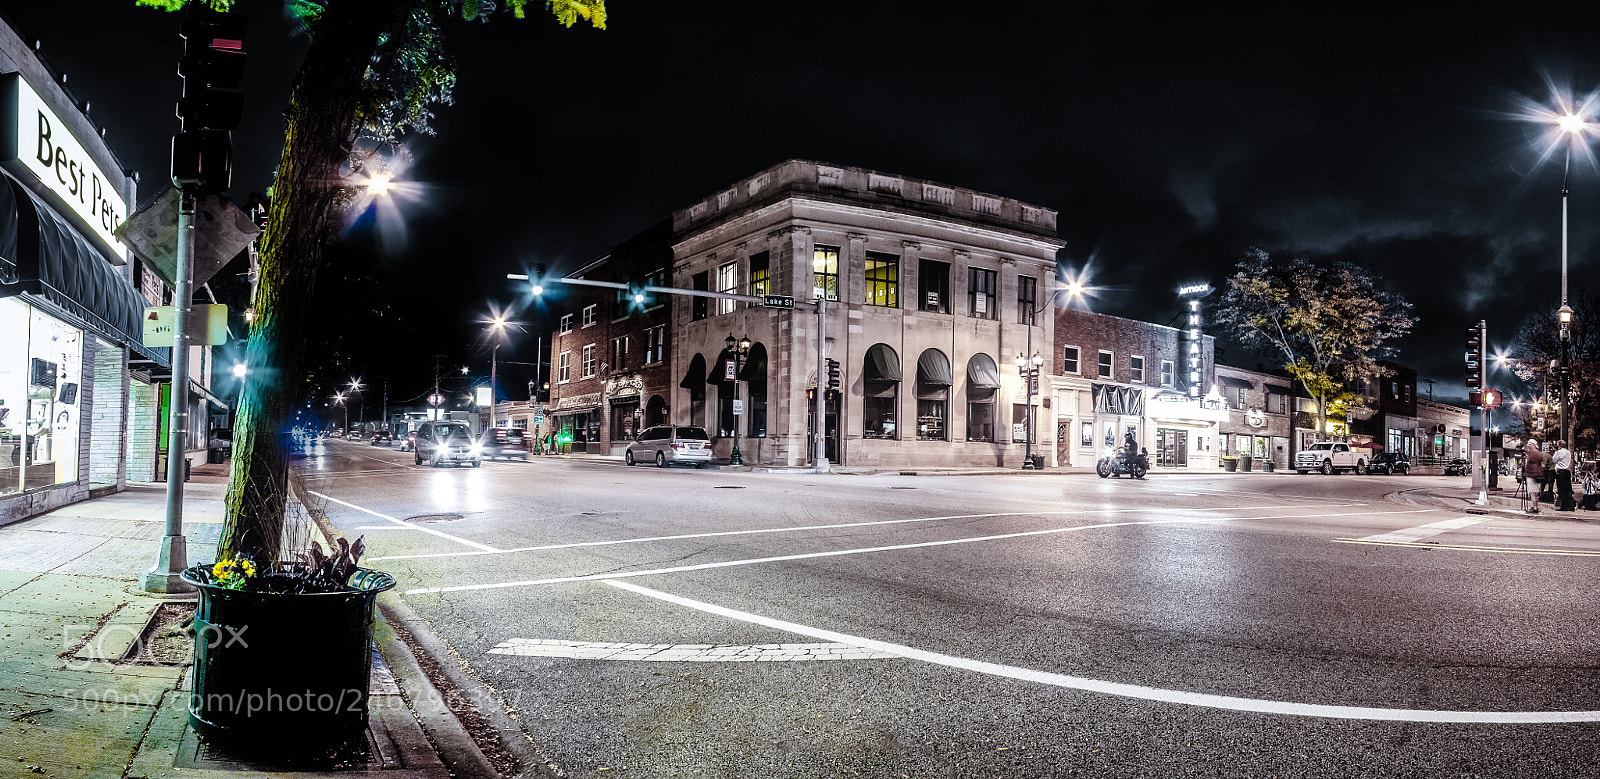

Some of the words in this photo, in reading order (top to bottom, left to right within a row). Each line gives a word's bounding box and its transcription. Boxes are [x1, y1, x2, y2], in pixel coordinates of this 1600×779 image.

[36, 109, 86, 204] Best
[91, 172, 120, 243] Pets
[765, 297, 783, 306] Lake
[784, 299, 793, 307] St
[1189, 300, 1200, 397] THEATRE
